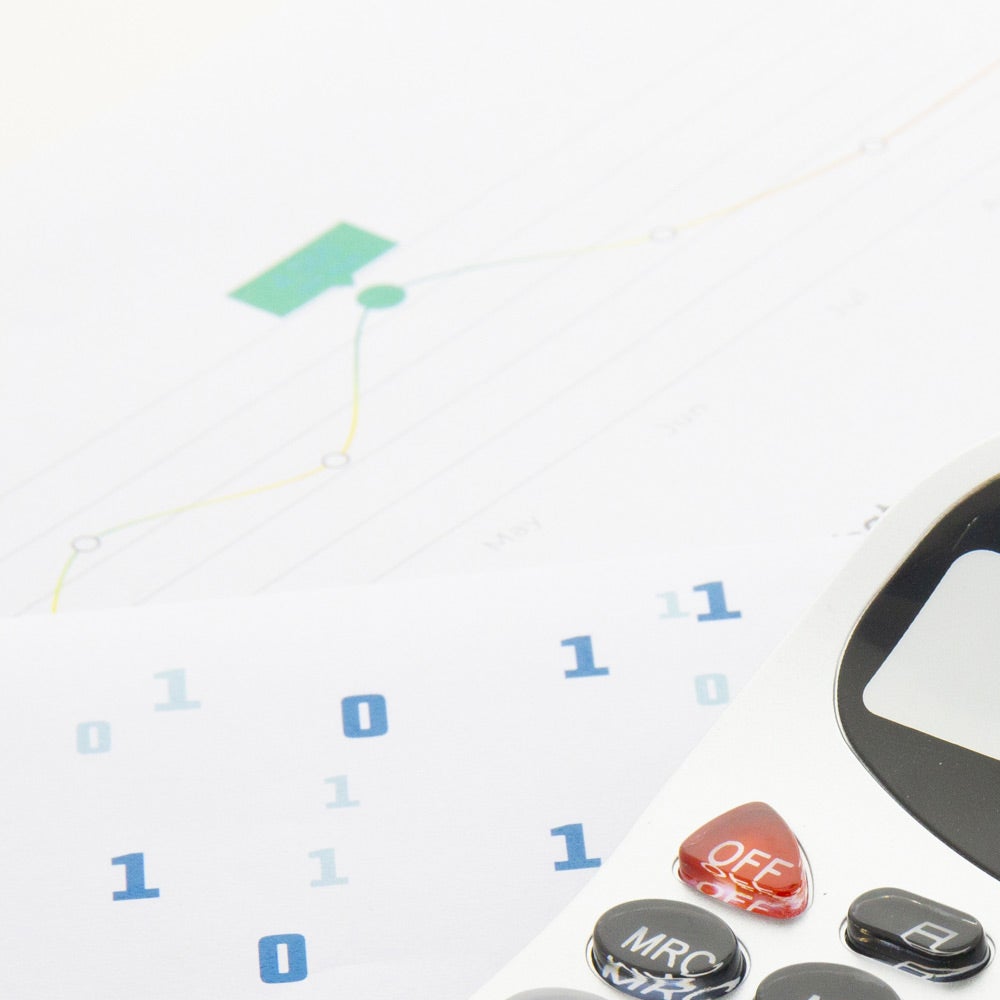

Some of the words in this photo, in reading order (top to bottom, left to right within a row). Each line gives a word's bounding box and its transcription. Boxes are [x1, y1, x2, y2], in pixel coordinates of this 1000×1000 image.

[483, 513, 544, 551] May
[692, 581, 742, 622] 1
[560, 634, 610, 679] 1
[341, 694, 389, 738] 0
[550, 822, 601, 872] 1
[707, 840, 794, 888] OFF
[111, 852, 160, 901] 1
[258, 933, 308, 984] 0
[621, 926, 724, 976] MRC
